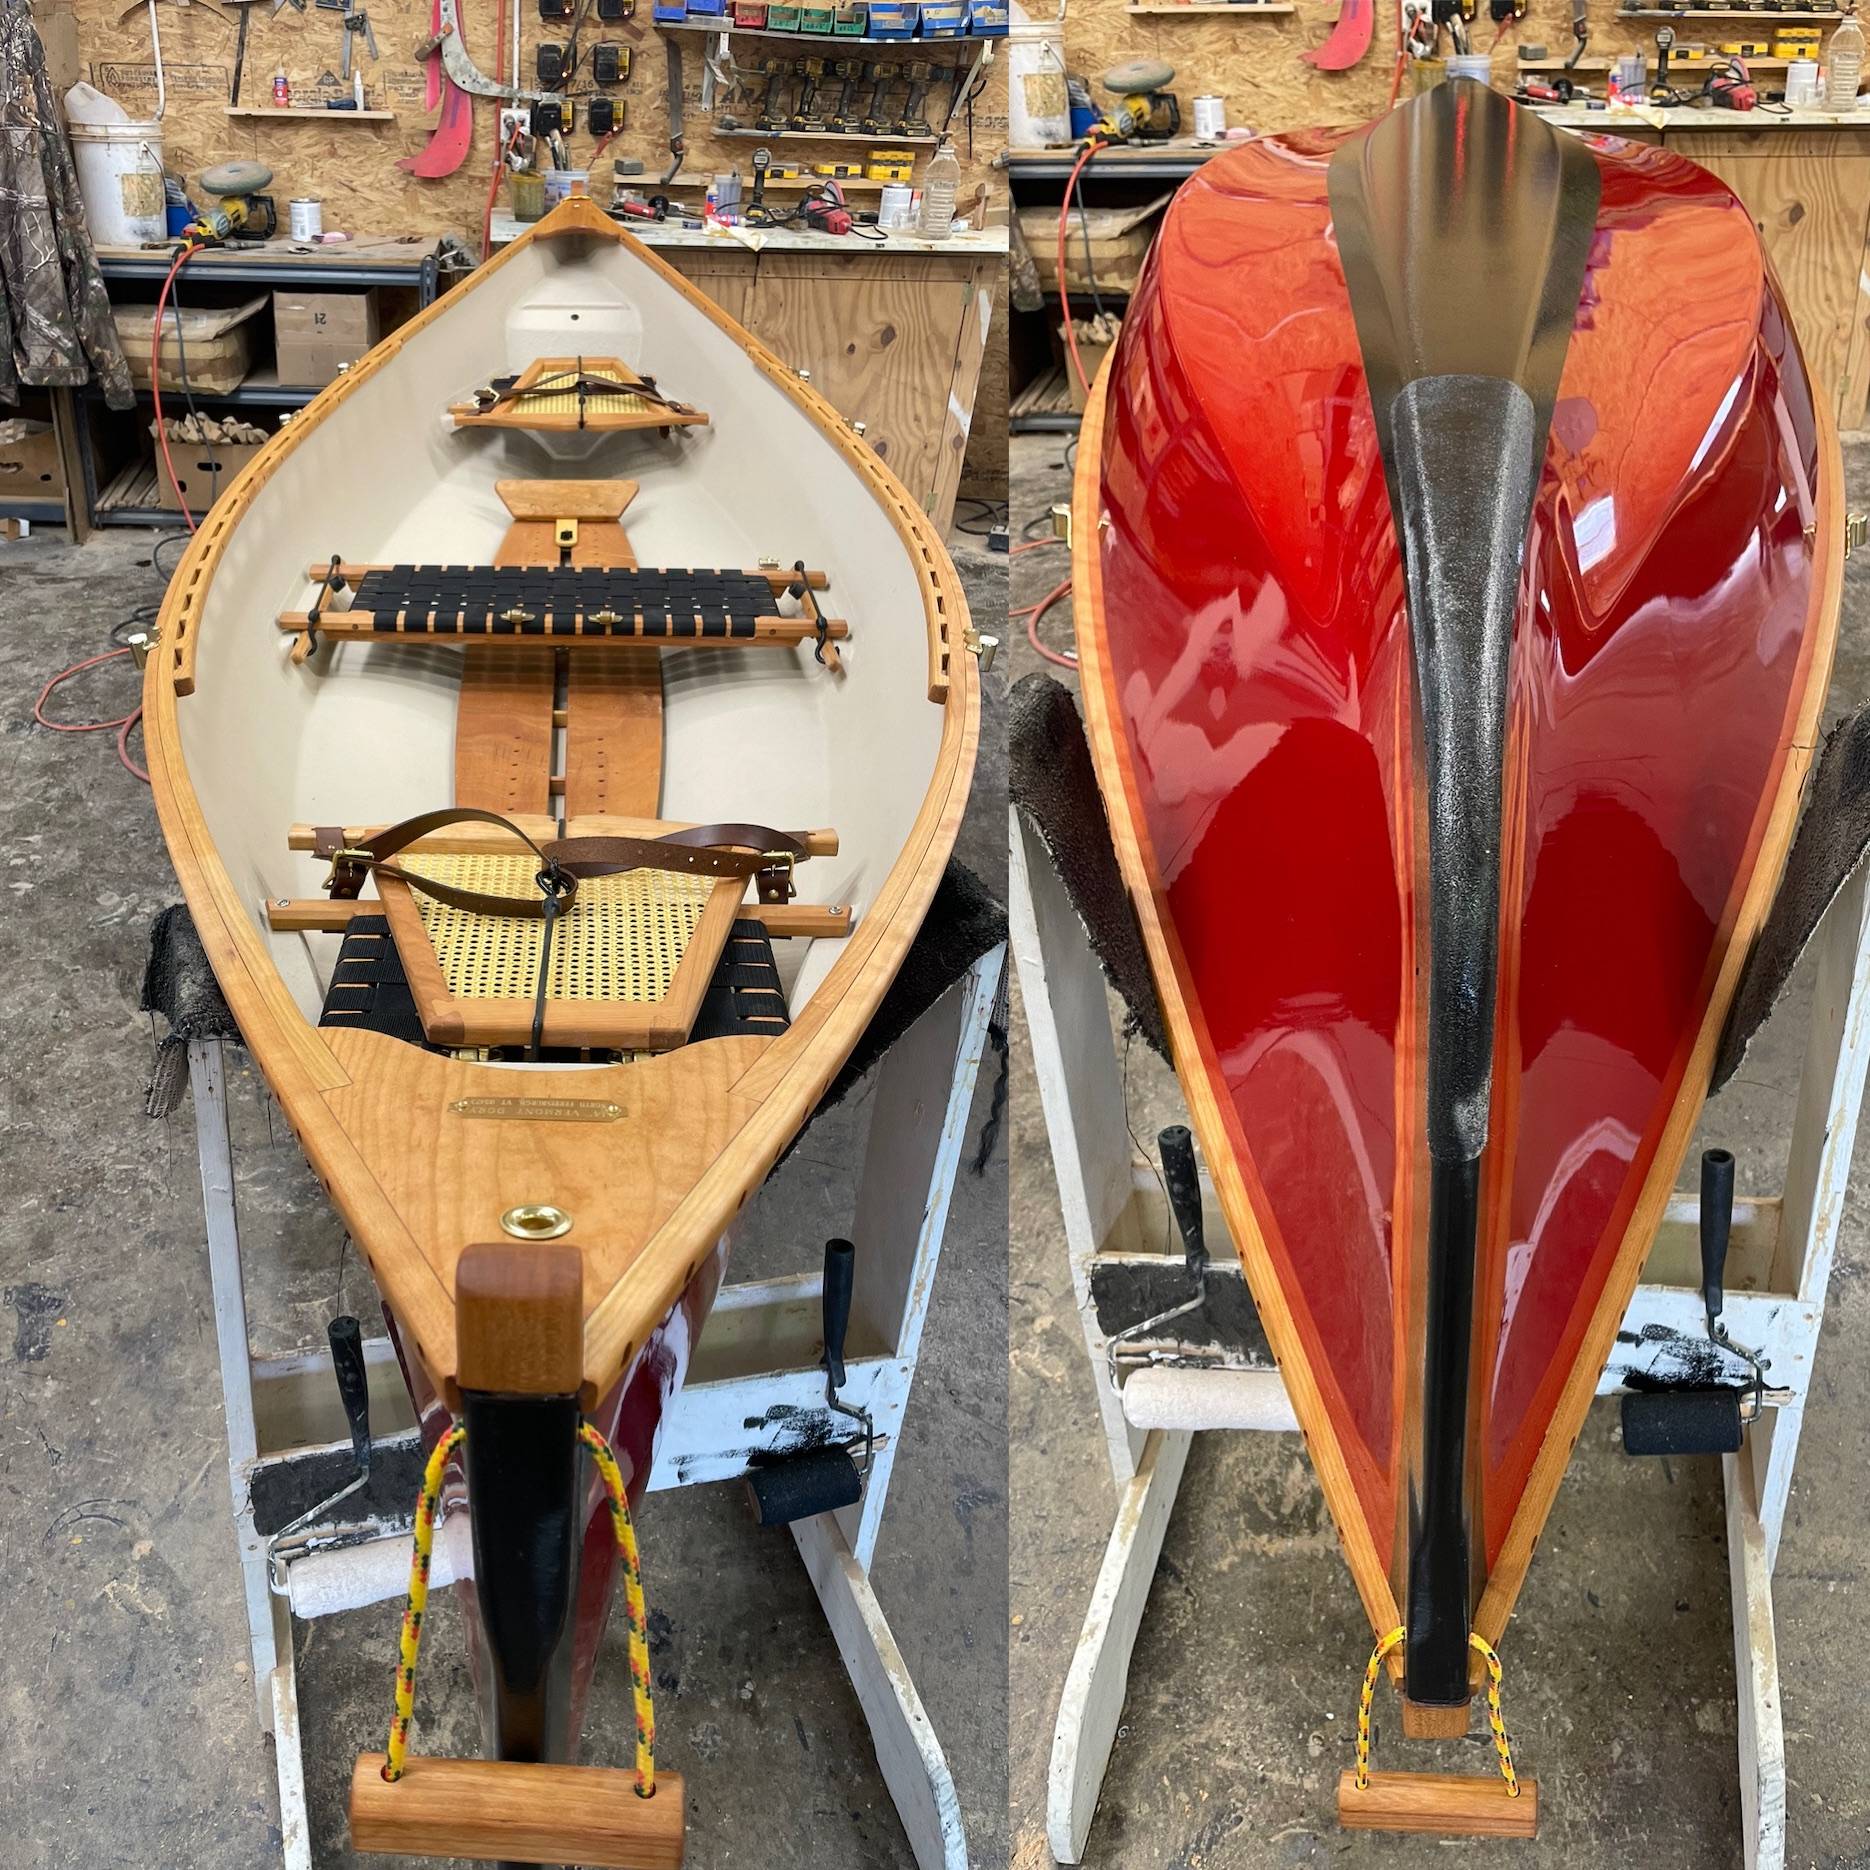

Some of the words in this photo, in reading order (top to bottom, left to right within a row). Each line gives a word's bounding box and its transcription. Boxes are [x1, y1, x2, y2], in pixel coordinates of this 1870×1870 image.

[314, 313, 327, 325] 21
[579, 1101, 606, 1109] NORTH
[468, 1106, 505, 1115] DORY
[515, 1108, 580, 1118] VERMONT
